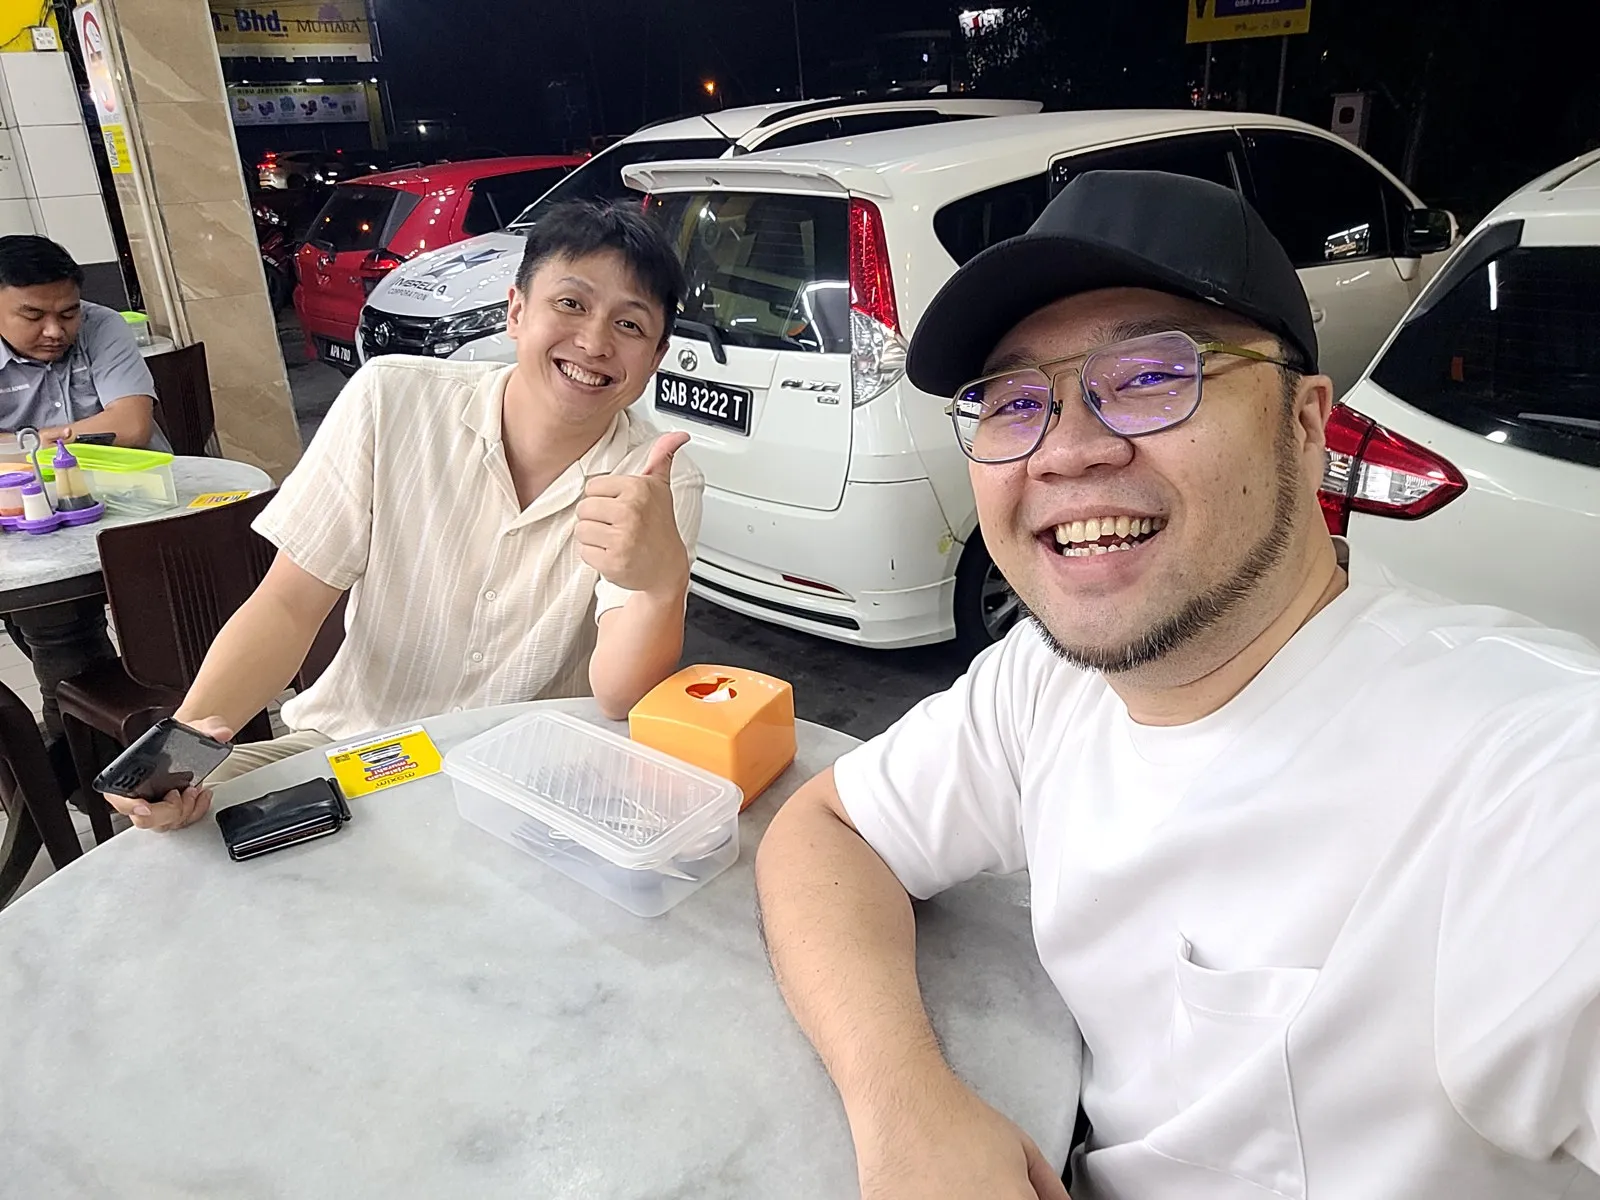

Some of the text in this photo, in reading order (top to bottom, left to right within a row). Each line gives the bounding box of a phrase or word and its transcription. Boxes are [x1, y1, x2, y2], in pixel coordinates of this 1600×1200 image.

[234, 8, 288, 33] Bhd.
[297, 18, 362, 34] MUTIARA
[387, 287, 428, 301] CORPORATION
[781, 379, 842, 393] ALZA
[661, 378, 743, 421] SAB 3222 T
[366, 763, 417, 781] Perjalanan
